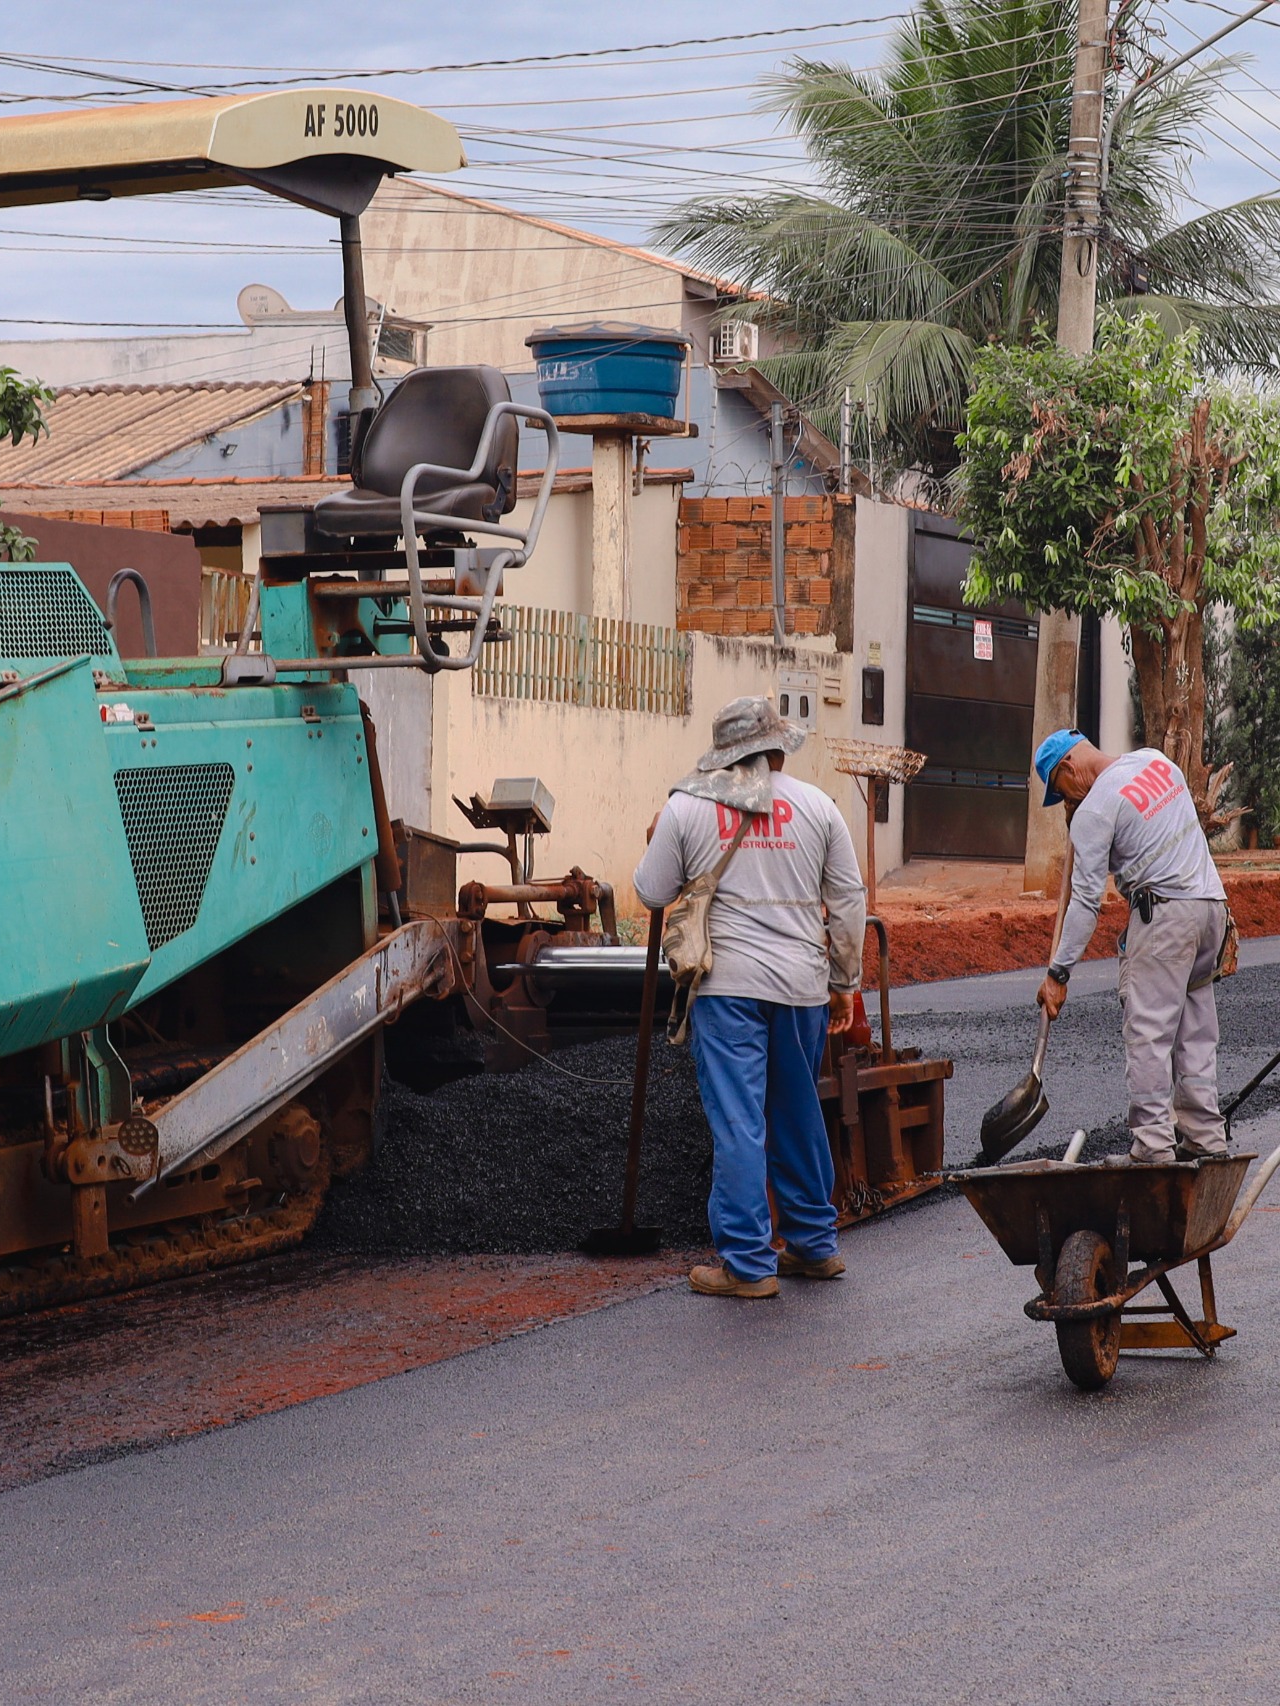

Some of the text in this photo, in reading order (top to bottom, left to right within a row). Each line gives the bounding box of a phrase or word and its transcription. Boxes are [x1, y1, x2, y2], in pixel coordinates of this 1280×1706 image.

[304, 104, 379, 137] AF 5000
[1119, 759, 1174, 813] DMP
